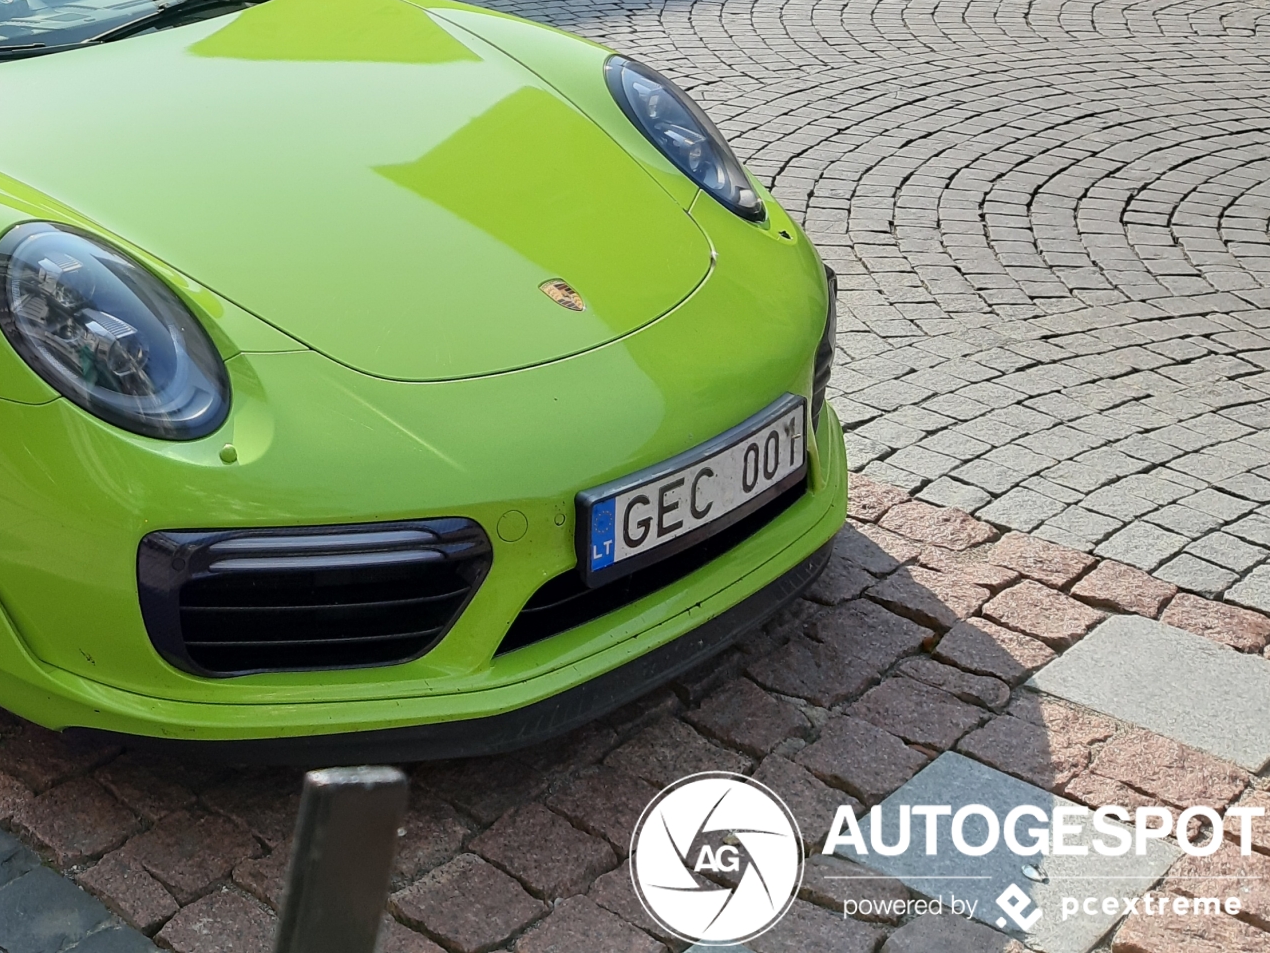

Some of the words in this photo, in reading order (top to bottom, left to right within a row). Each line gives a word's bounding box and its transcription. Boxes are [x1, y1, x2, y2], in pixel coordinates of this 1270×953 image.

[593, 539, 613, 560] LT
[622, 466, 715, 549] GEC
[742, 416, 797, 494] 001
